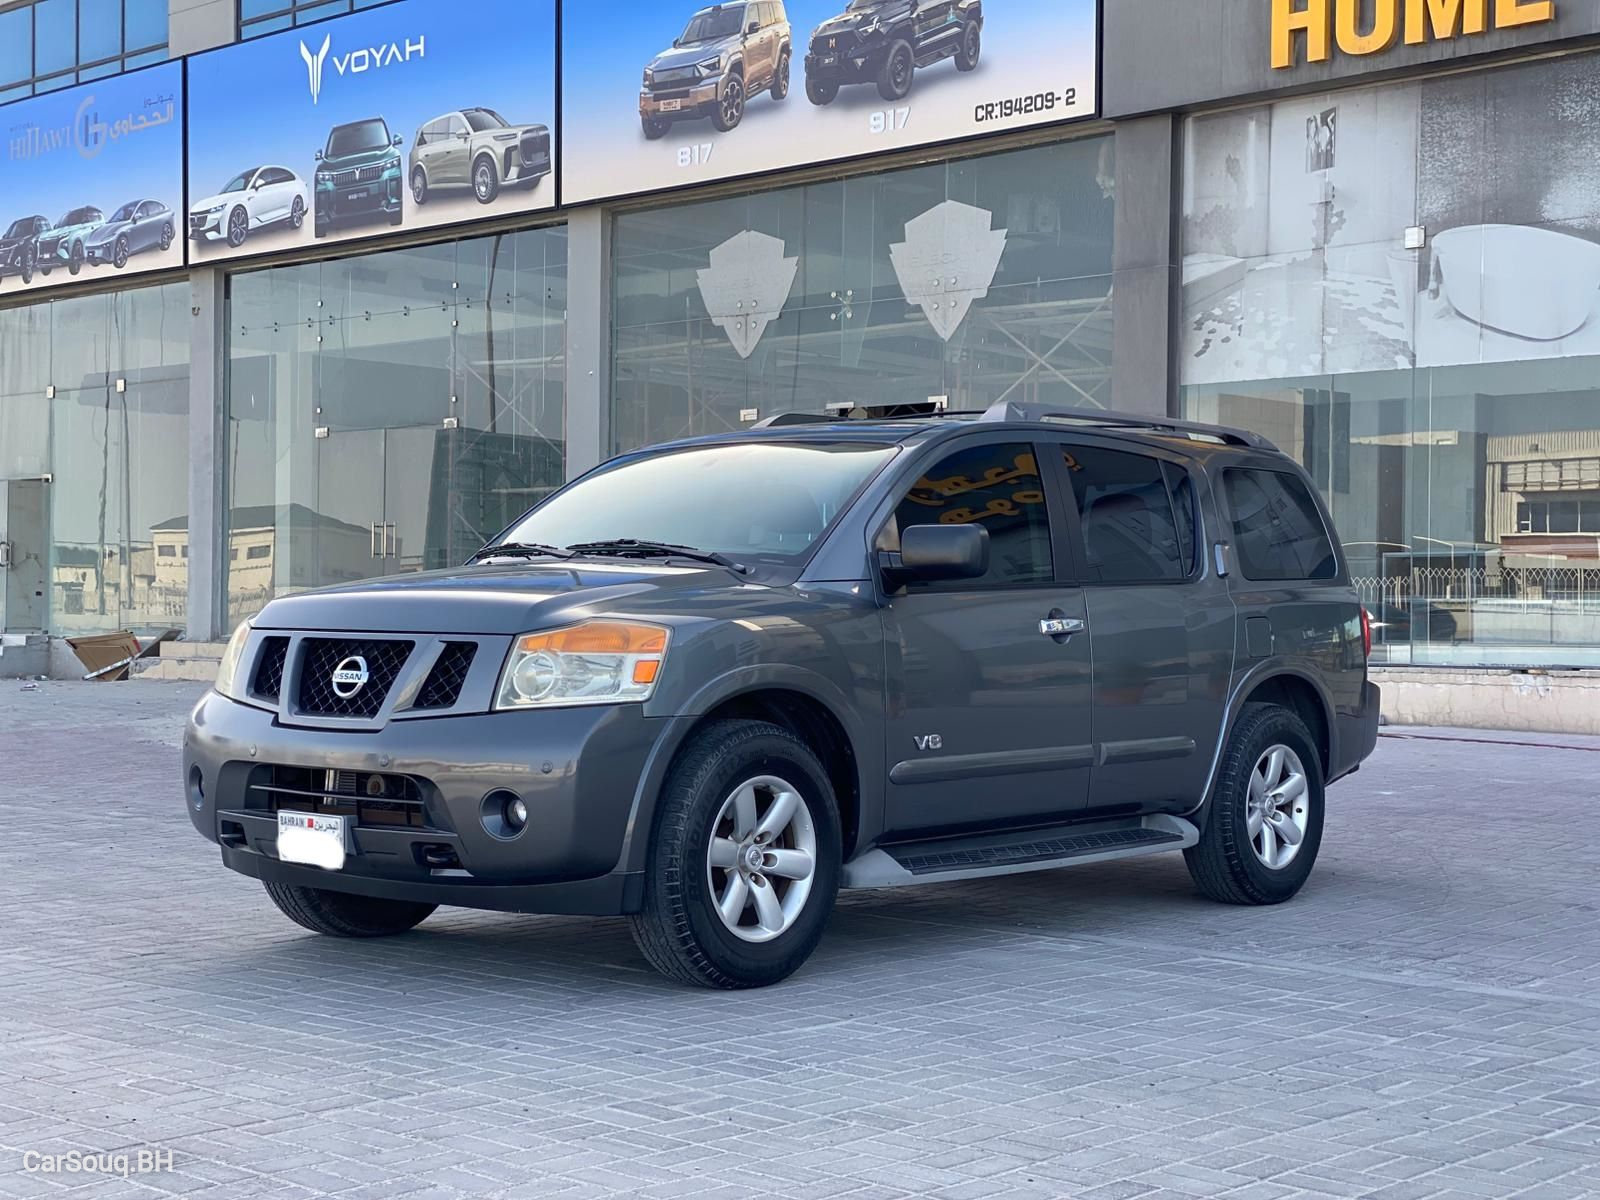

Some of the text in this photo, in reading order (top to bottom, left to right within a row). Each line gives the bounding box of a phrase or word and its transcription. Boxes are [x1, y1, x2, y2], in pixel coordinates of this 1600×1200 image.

[1271, 0, 1554, 69] HO
[332, 35, 425, 76] VOYAH
[869, 106, 911, 133] 917
[677, 142, 714, 167] 817
[280, 815, 305, 828] BAHRAIN
